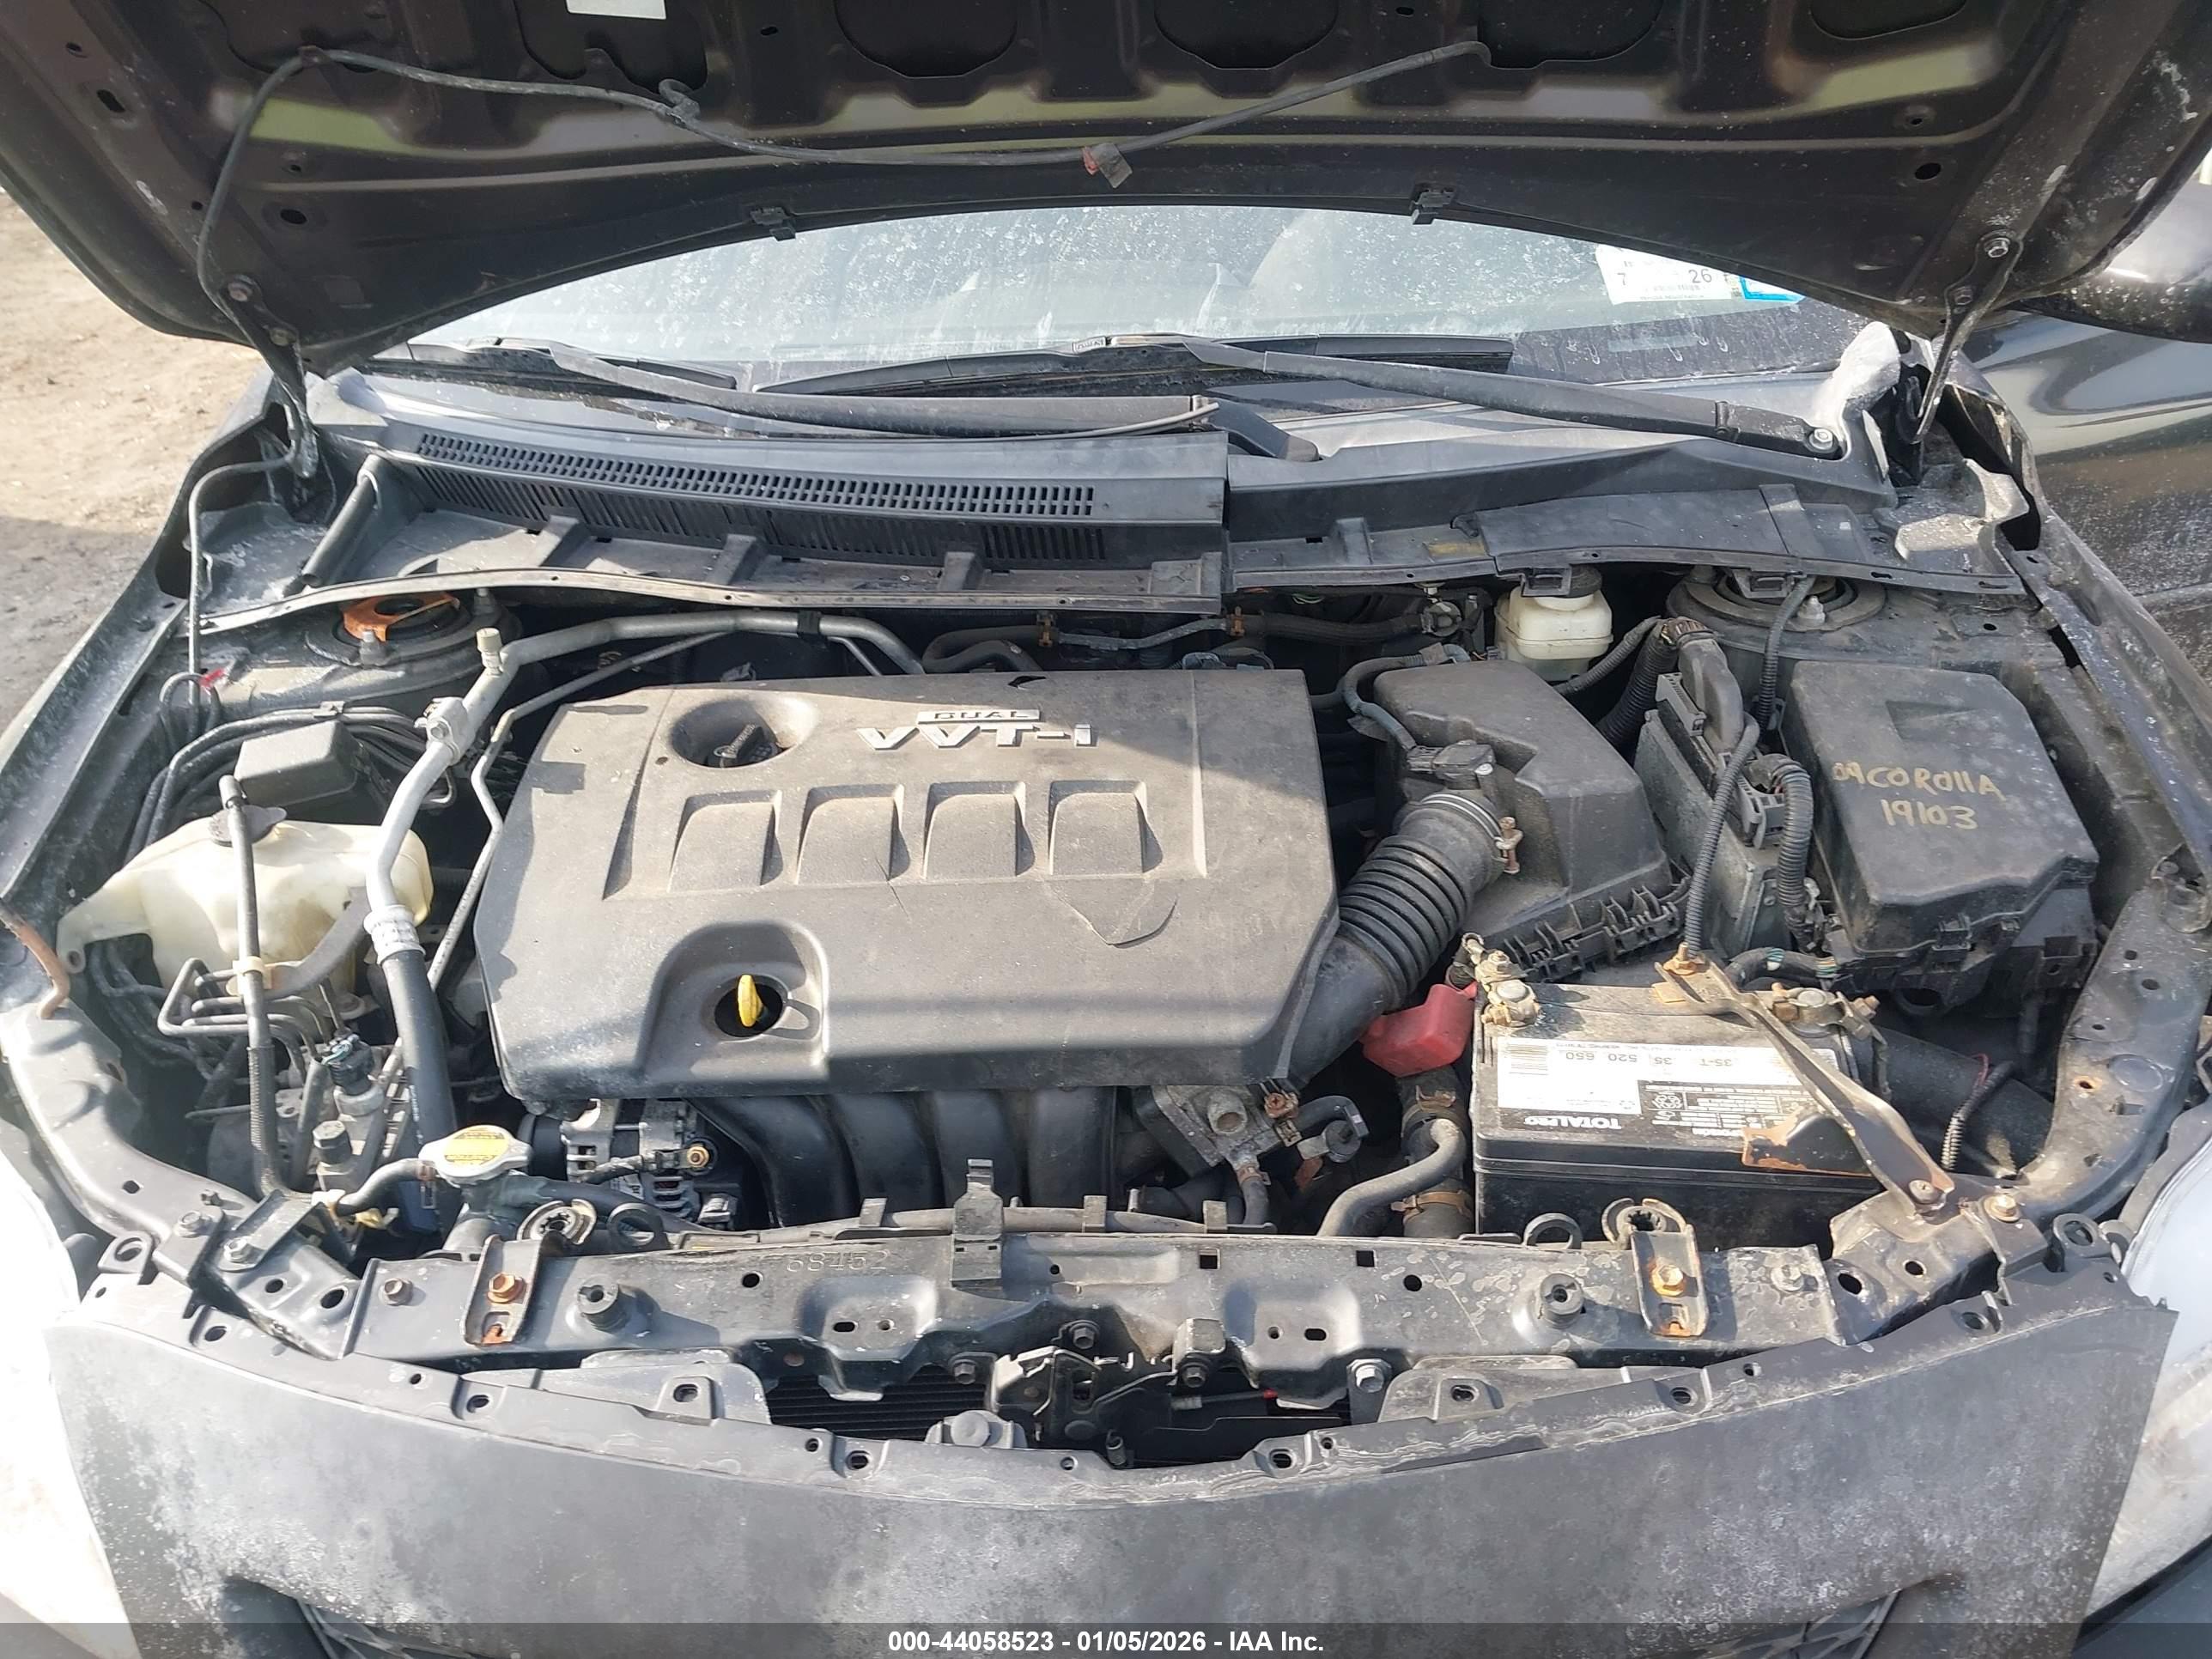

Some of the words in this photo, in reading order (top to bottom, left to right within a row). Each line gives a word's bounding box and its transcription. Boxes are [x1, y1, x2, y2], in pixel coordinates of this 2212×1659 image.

[1688, 269, 1712, 283] 26
[934, 710, 1030, 720] DUAL
[1881, 799, 1978, 830] 19103
[1565, 1051, 1595, 1062] 650
[1607, 1053, 1638, 1064] 520
[1653, 1056, 1674, 1066] 35
[1698, 1056, 1733, 1067] 35-T
